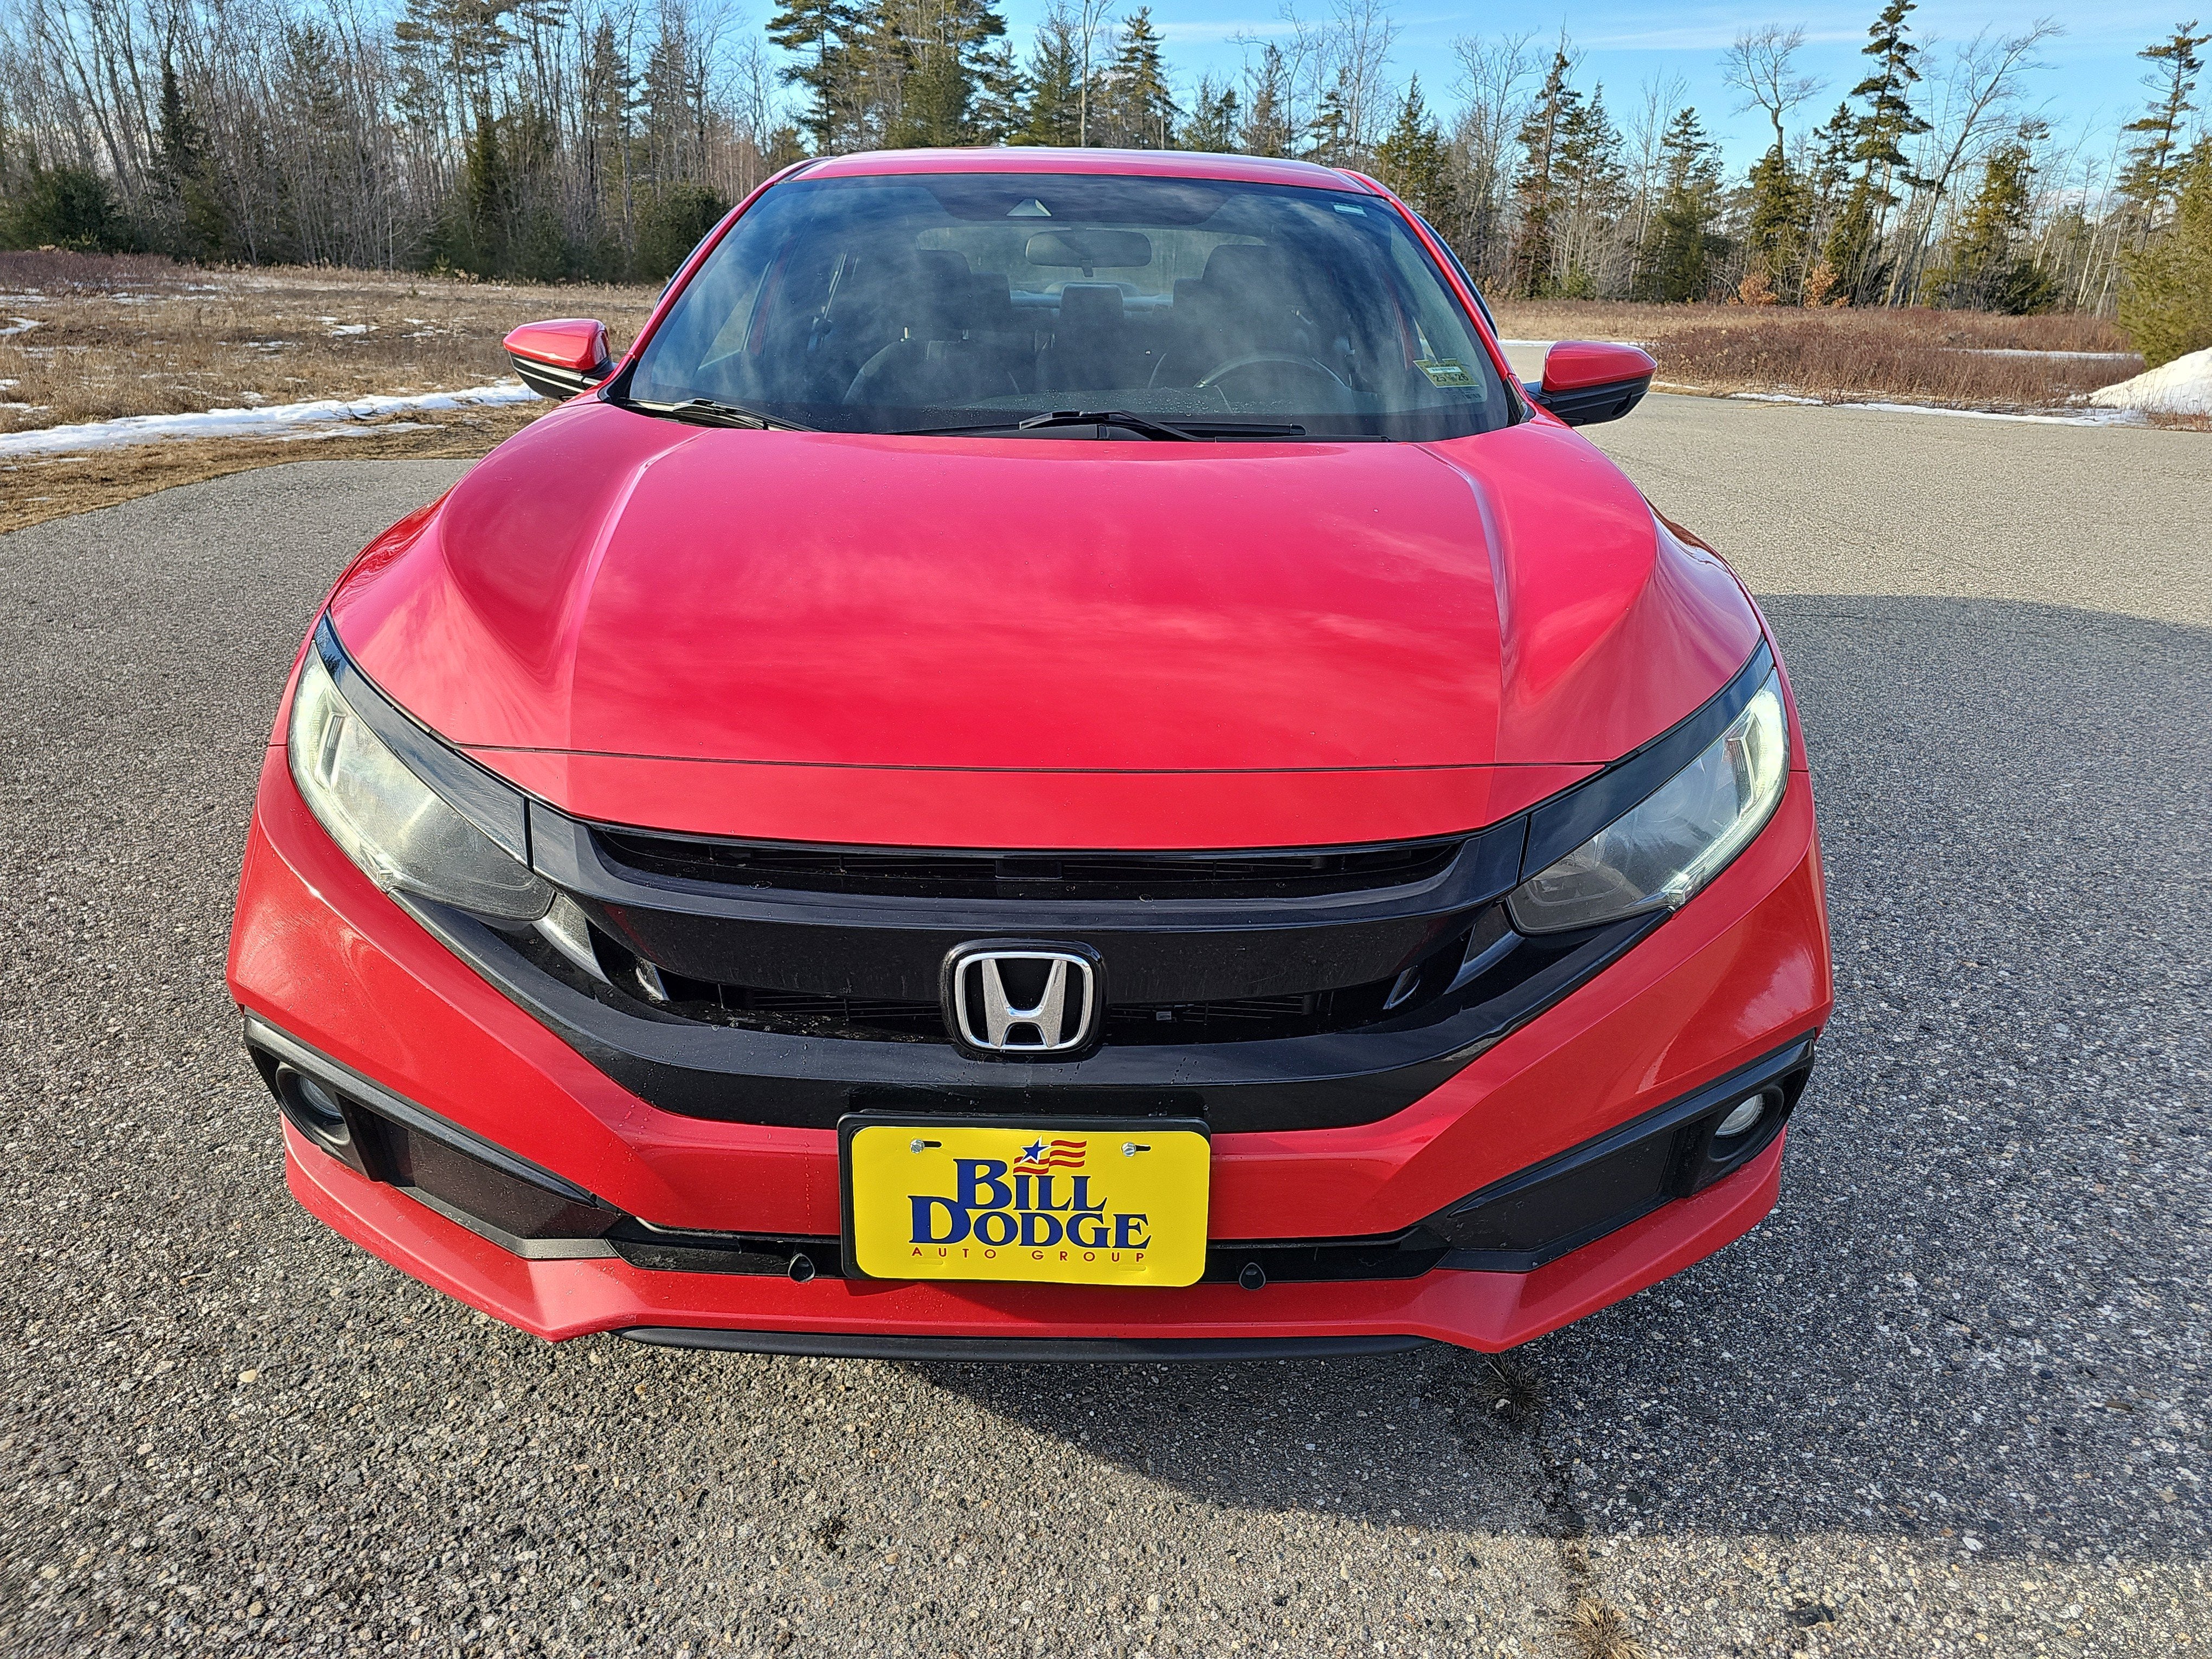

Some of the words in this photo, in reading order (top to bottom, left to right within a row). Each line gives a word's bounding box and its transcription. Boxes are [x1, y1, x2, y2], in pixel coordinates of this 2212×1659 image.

[953, 1158, 1108, 1212] BILL
[907, 1195, 1152, 1250] DODGE
[911, 1246, 996, 1259] AUTO
[1031, 1250, 1144, 1262] GROUP
